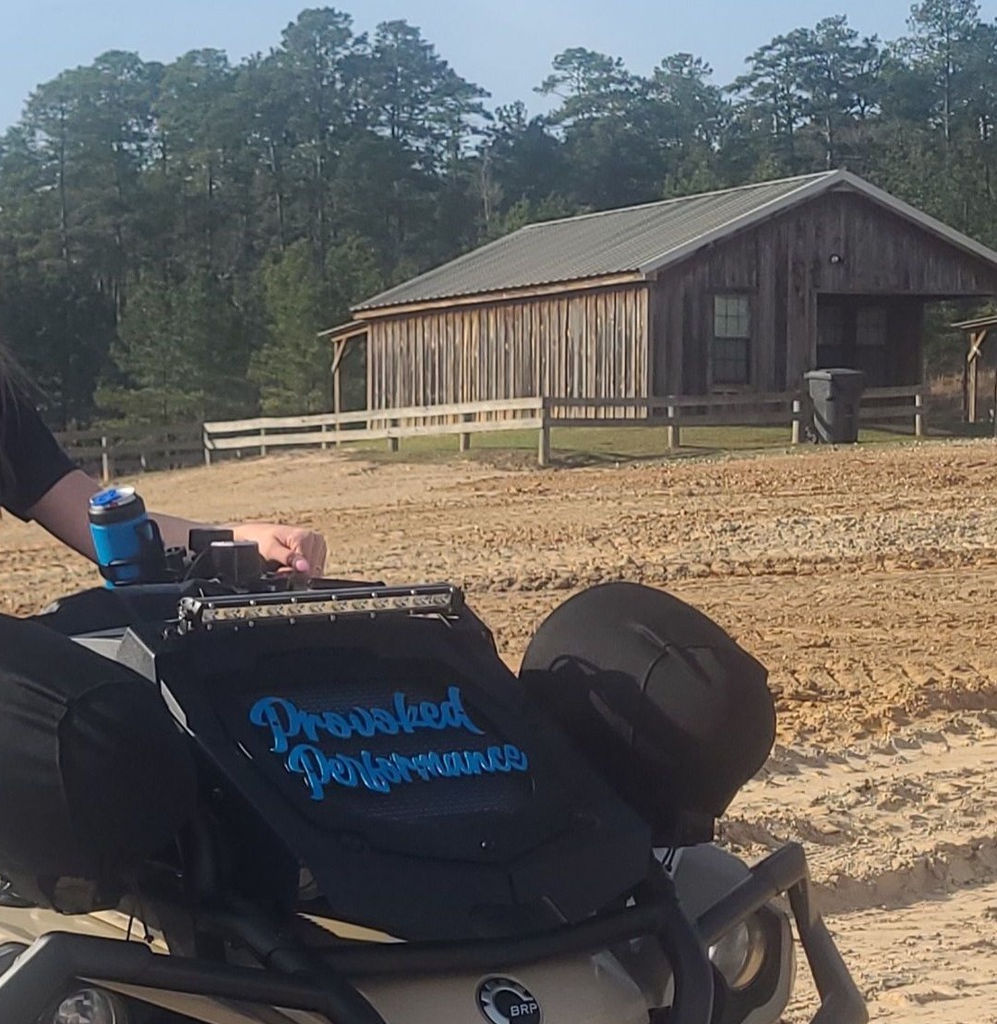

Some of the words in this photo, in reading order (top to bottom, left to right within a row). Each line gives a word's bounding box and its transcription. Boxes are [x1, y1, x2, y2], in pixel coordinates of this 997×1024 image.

[249, 686, 485, 753] Provoked
[288, 743, 529, 801] Performance
[510, 1002, 538, 1017] BRP
